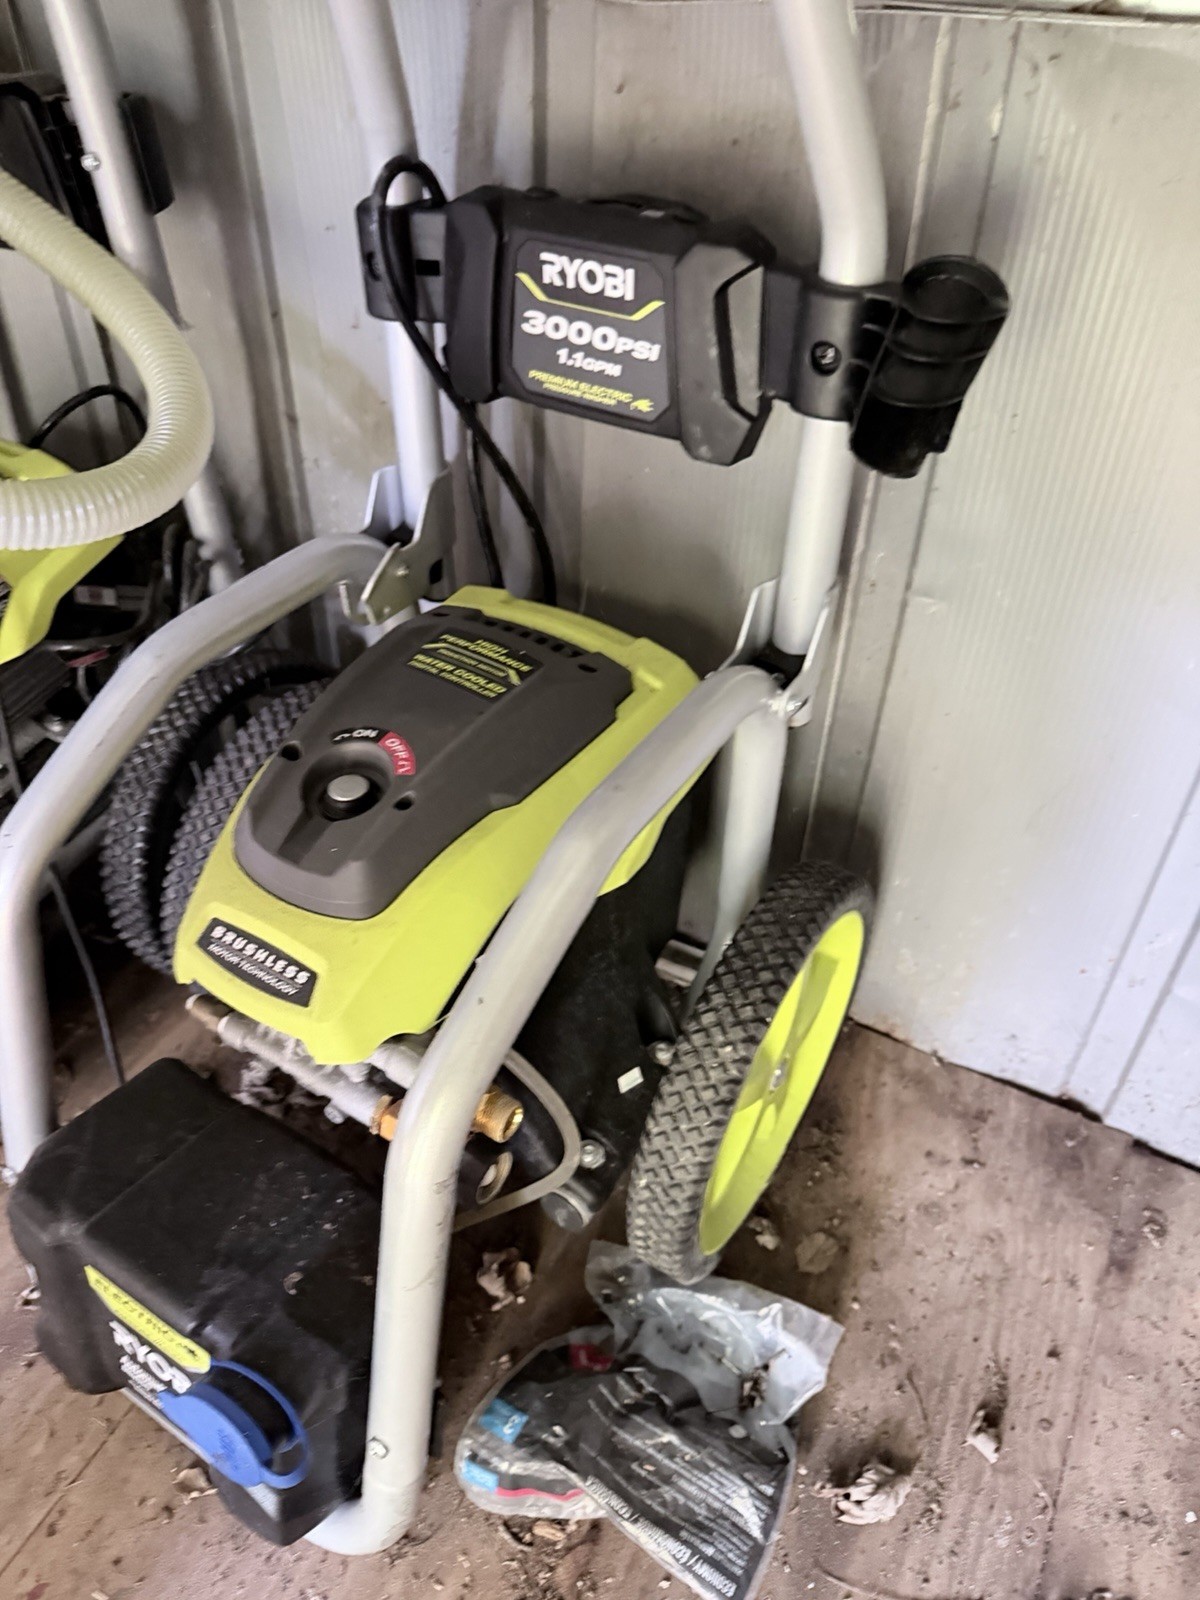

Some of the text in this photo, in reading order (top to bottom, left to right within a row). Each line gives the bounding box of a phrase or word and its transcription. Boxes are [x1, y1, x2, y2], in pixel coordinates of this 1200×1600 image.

[539, 252, 635, 301] RYOBI
[439, 634, 534, 672] PERFORMANCE
[454, 669, 508, 694] COOLED
[210, 925, 311, 984] BRUSHLESS
